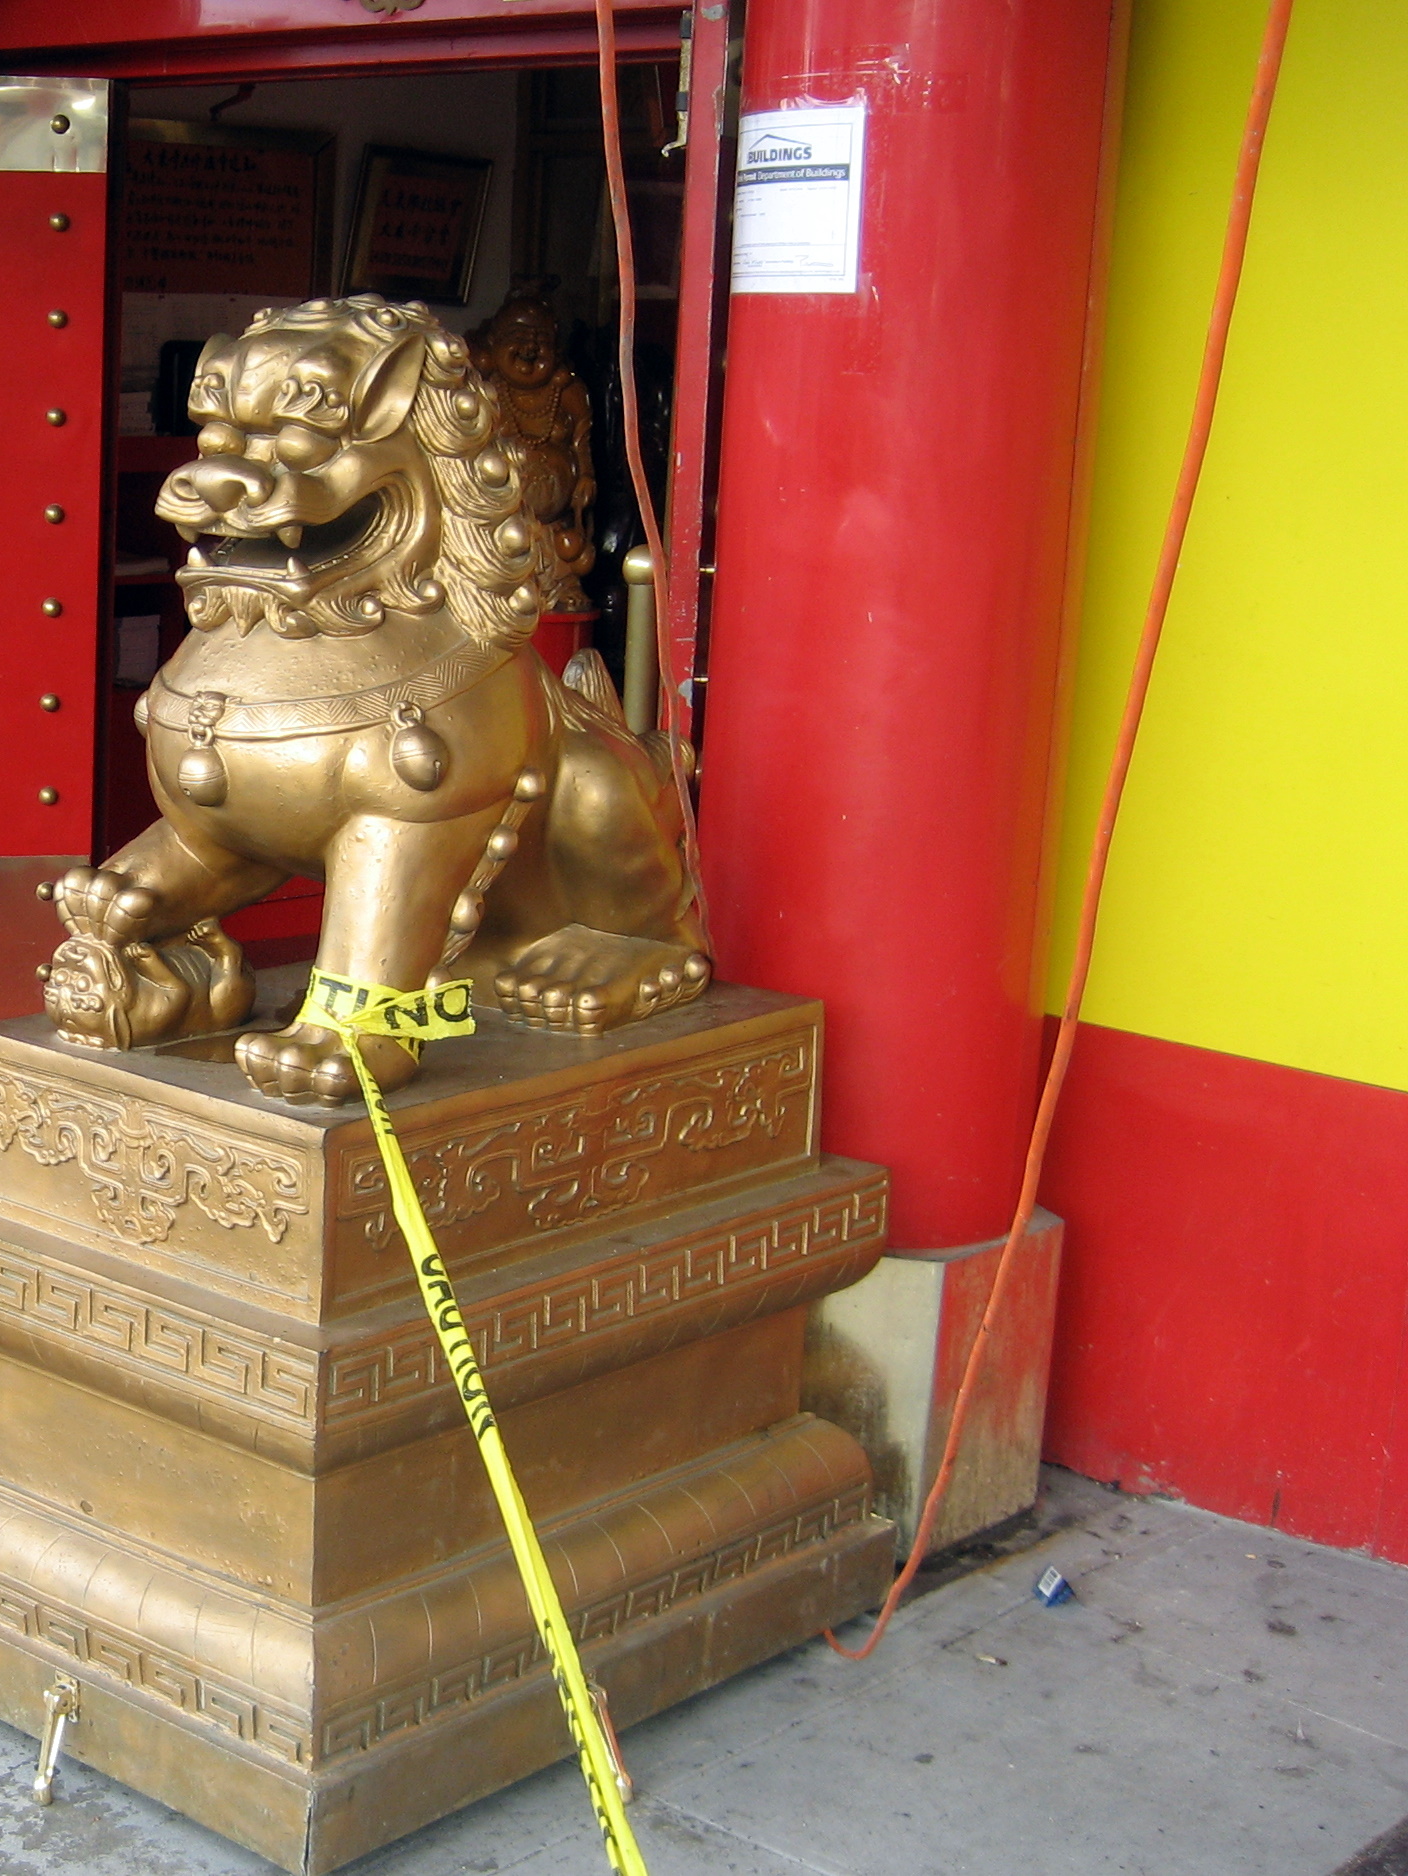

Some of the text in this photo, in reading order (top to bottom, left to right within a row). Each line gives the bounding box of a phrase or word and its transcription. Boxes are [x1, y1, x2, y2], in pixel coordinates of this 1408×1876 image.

[746, 147, 812, 165] BUILDINGS
[757, 170, 795, 182] Department
[796, 168, 805, 178] of
[806, 167, 847, 180] Buildings
